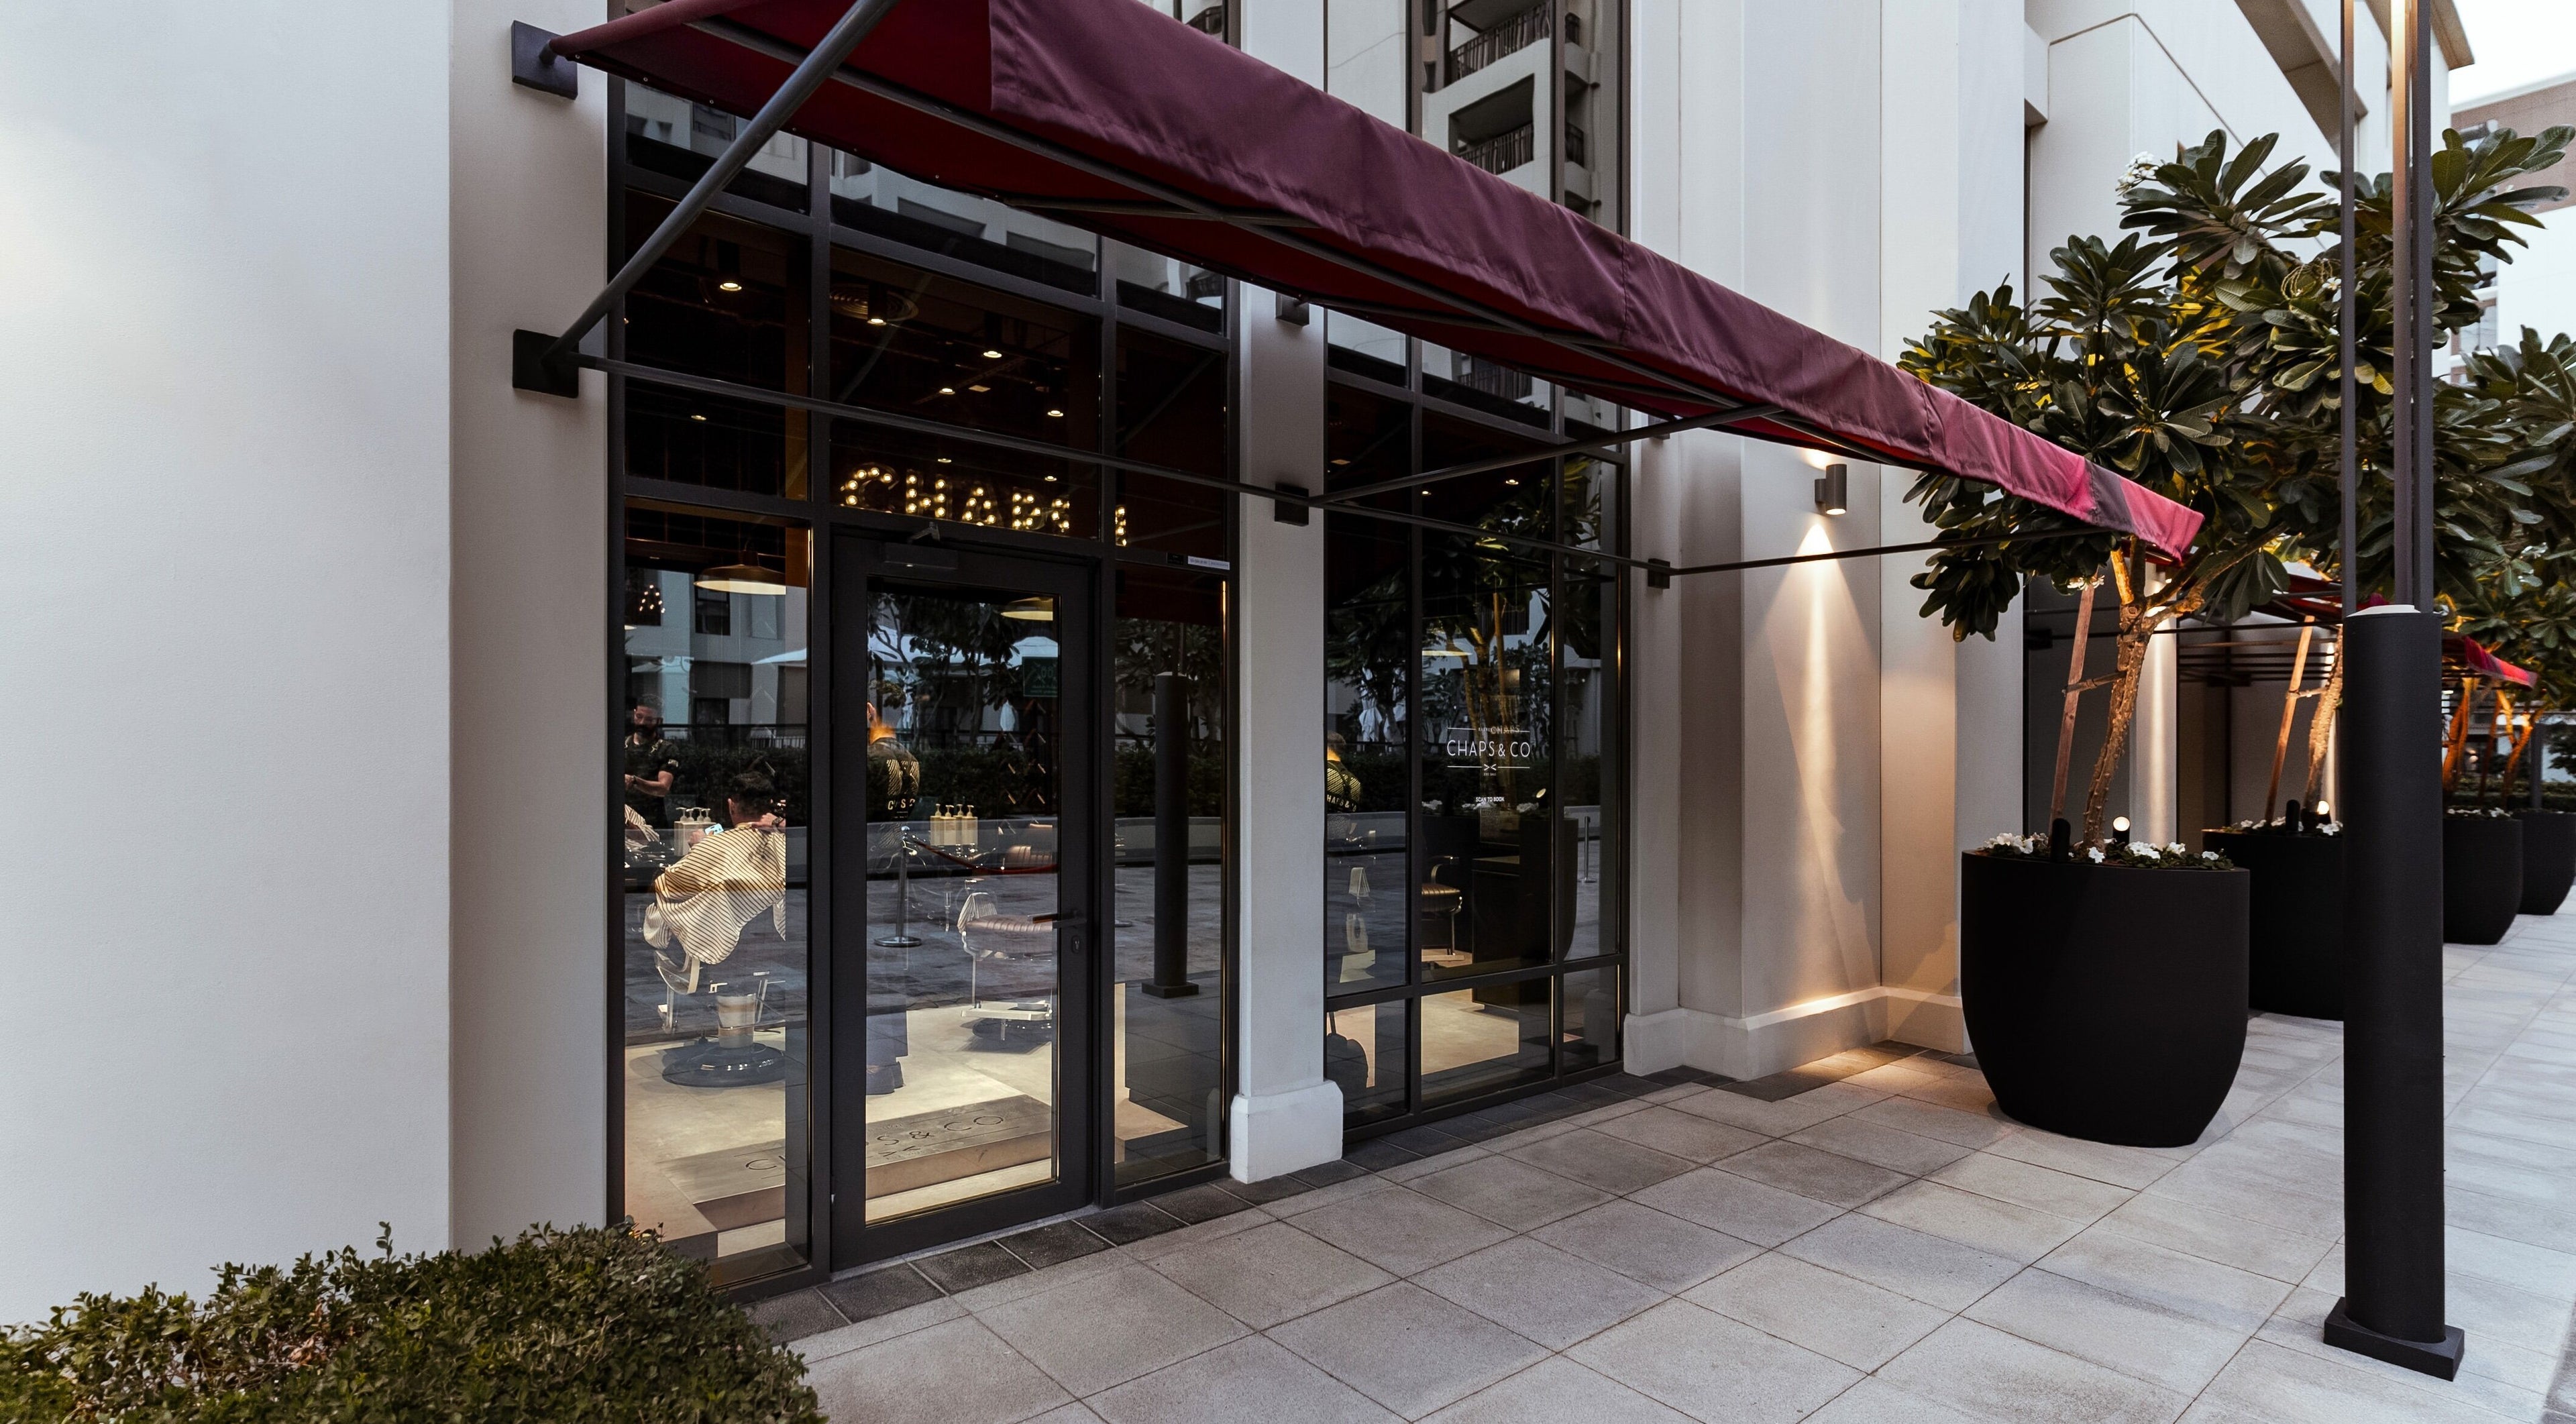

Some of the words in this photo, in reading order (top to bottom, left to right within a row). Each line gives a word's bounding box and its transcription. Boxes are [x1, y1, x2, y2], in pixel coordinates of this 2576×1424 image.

[1446, 740, 1495, 757] CHAPS
[1498, 743, 1506, 757] &
[1510, 741, 1531, 758] CO
[909, 1130, 934, 1140] &
[943, 1115, 1004, 1132] CO
